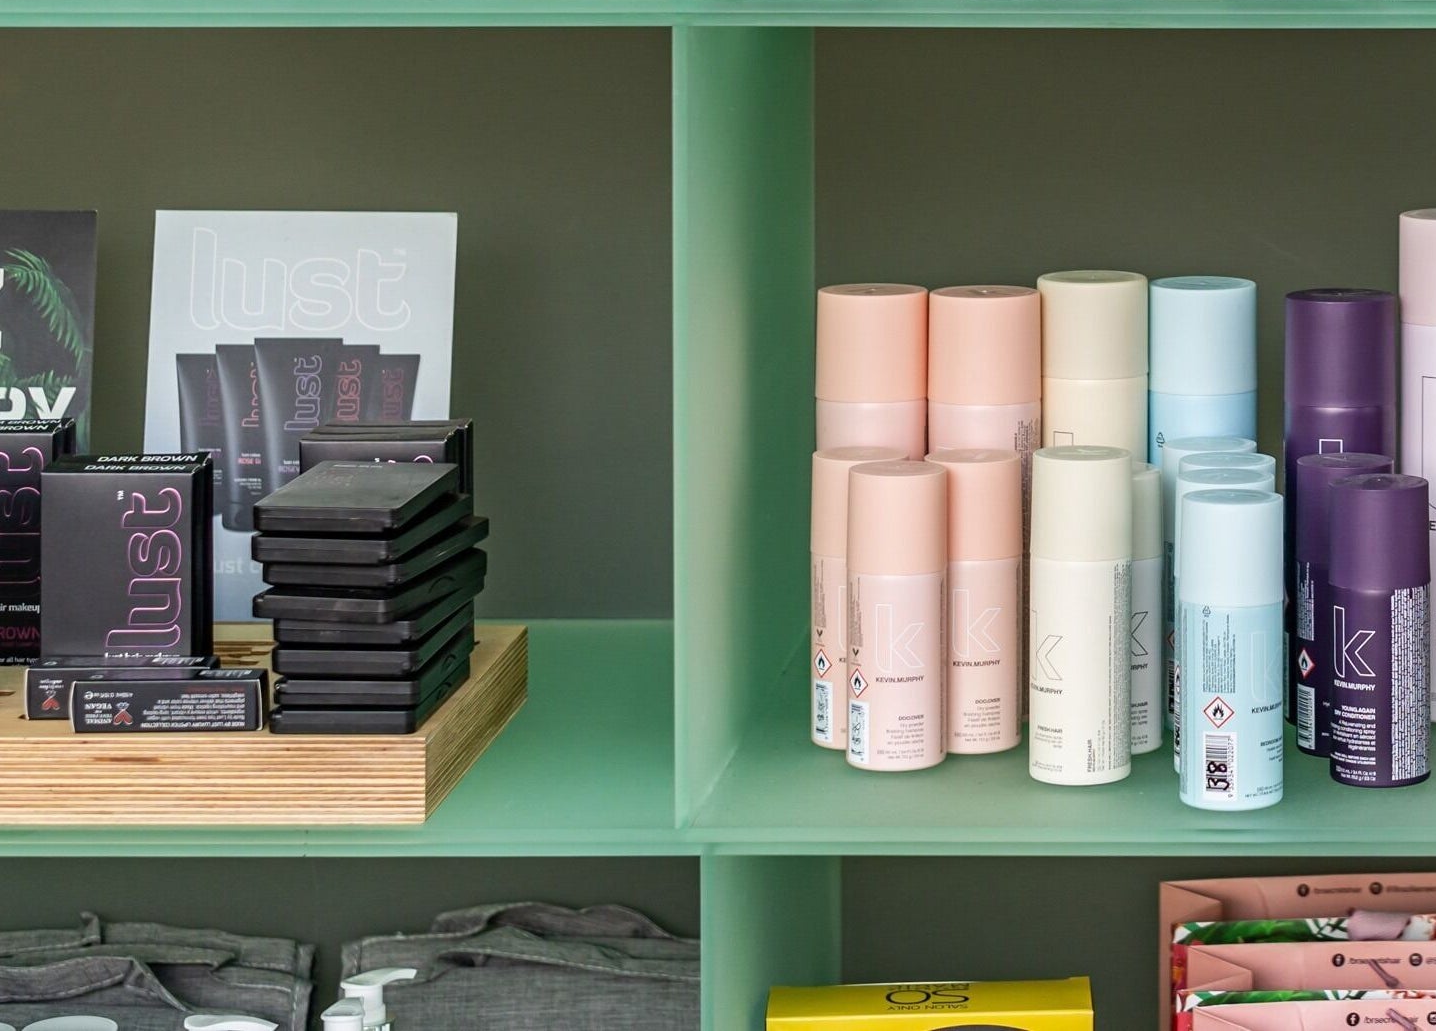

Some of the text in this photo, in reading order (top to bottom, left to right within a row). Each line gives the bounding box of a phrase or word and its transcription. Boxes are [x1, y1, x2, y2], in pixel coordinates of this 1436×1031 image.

[190, 227, 411, 332] lust
[284, 355, 322, 431] lust
[97, 455, 199, 463] DARK BROWN
[106, 487, 182, 648] lust
[1334, 679, 1376, 691] KEVIN.MURPHY
